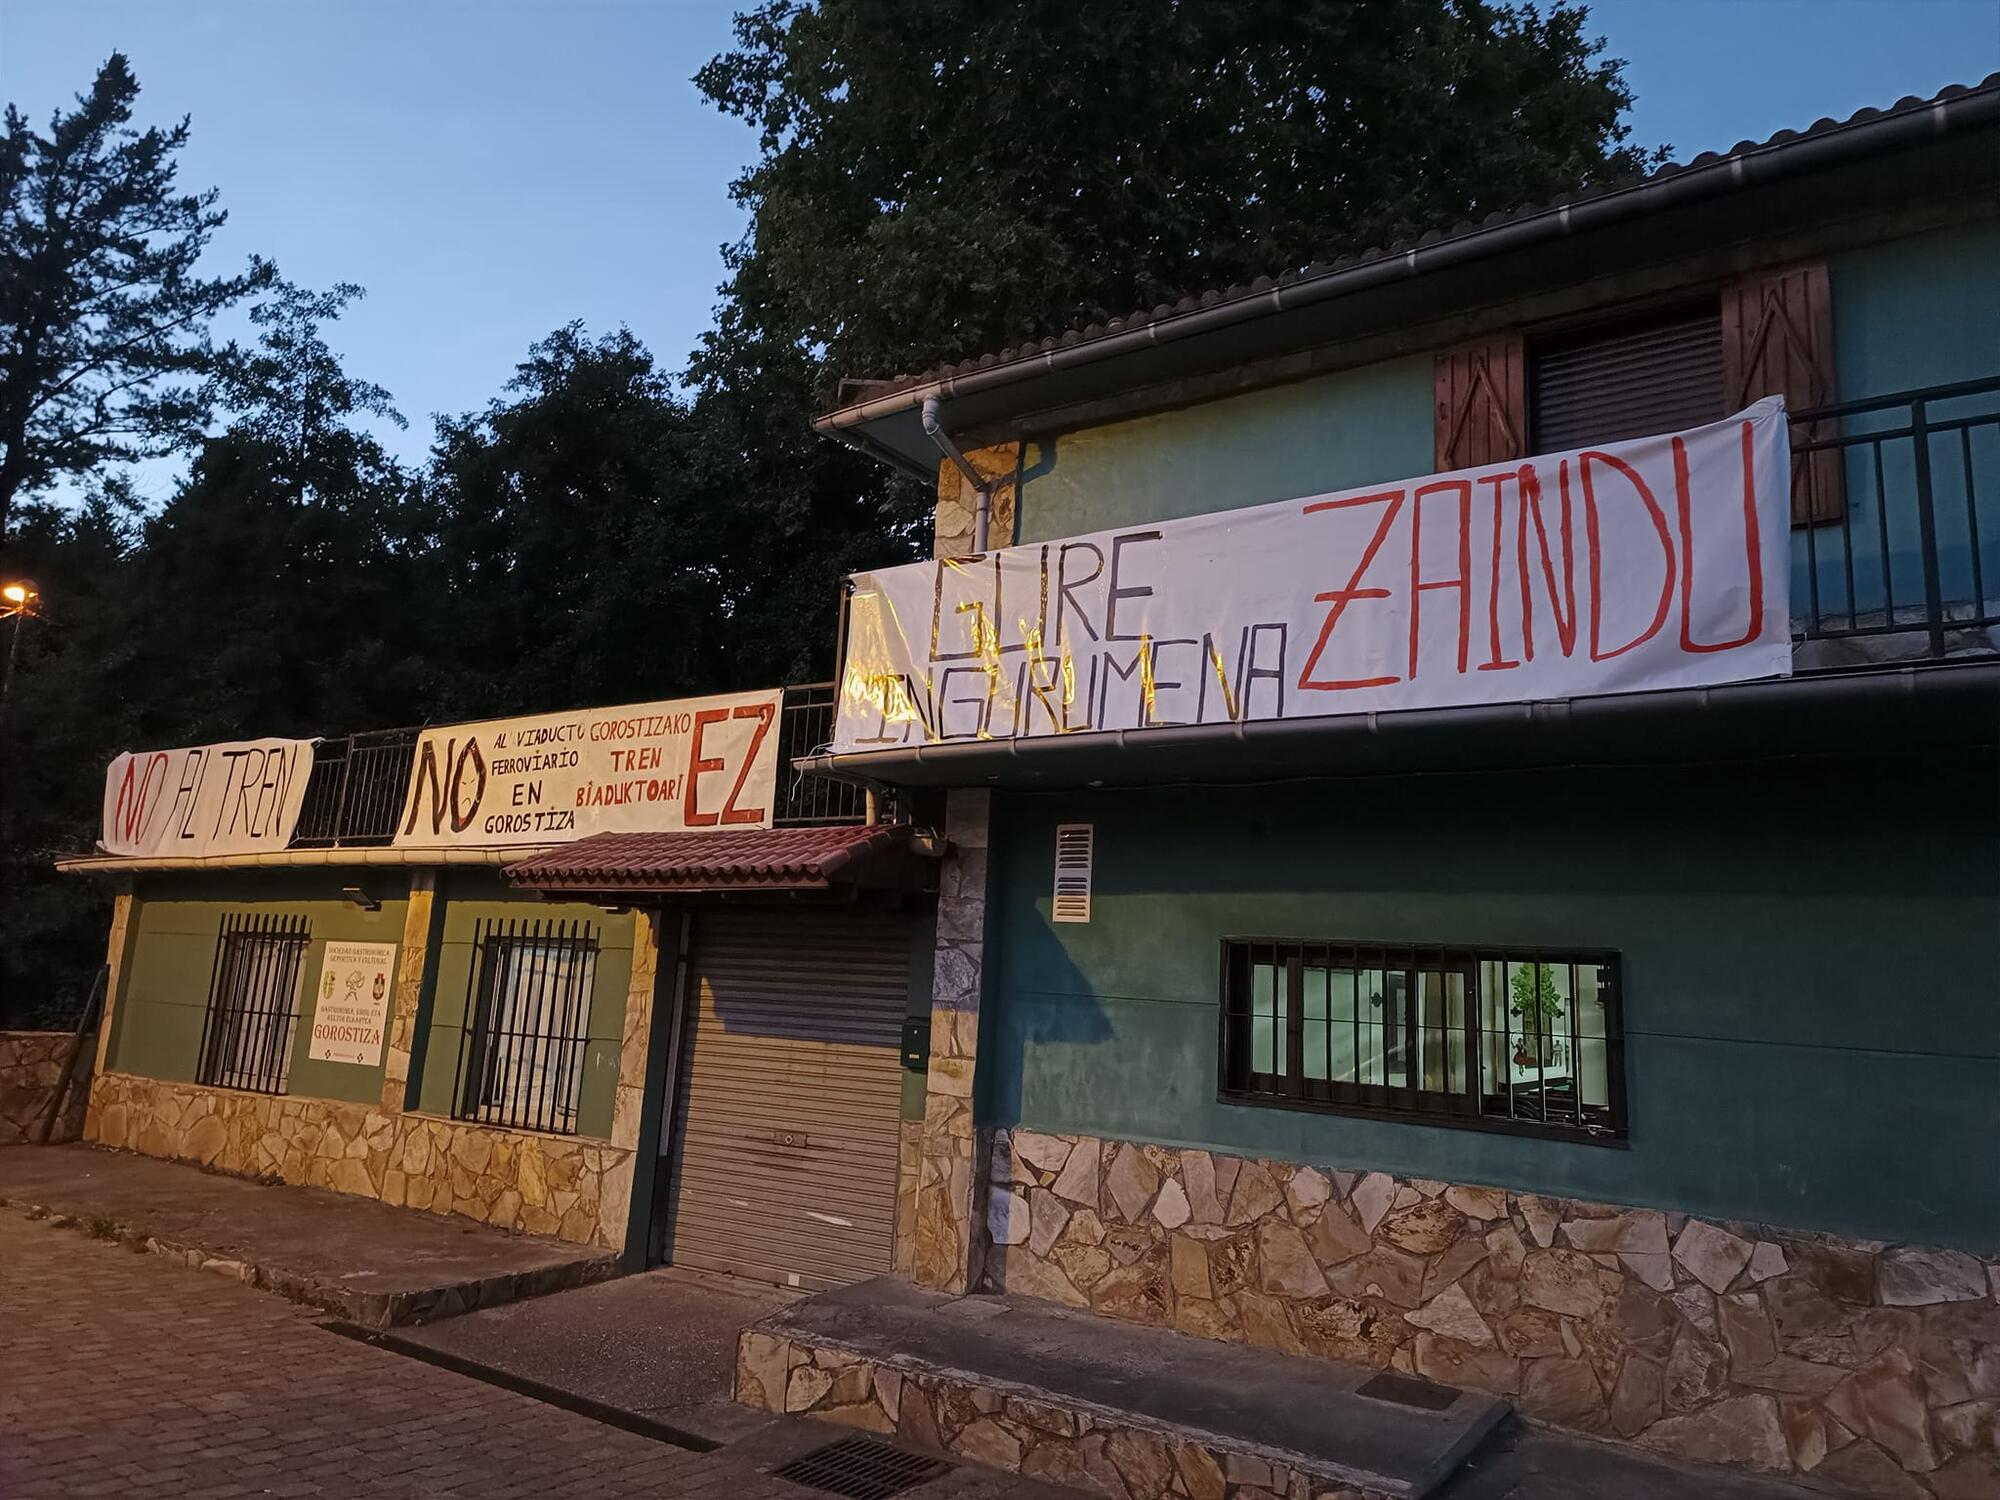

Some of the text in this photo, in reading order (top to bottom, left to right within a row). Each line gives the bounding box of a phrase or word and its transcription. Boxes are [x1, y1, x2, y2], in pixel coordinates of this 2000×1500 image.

[1298, 420, 1764, 690] ZAINDU
[928, 530, 1164, 662] GURE
[493, 724, 585, 749] AL VIADUCTO
[590, 713, 691, 742] GOROSTIZAKO
[491, 748, 579, 776] FERROVIARIO
[610, 747, 662, 772] TREN
[683, 703, 775, 827] EZ
[115, 743, 298, 845] NO AL TREN
[404, 736, 487, 836] NO
[512, 780, 542, 806] EN
[484, 806, 575, 834] GOROSTIZA
[314, 1024, 380, 1045] GOROSTIZA
